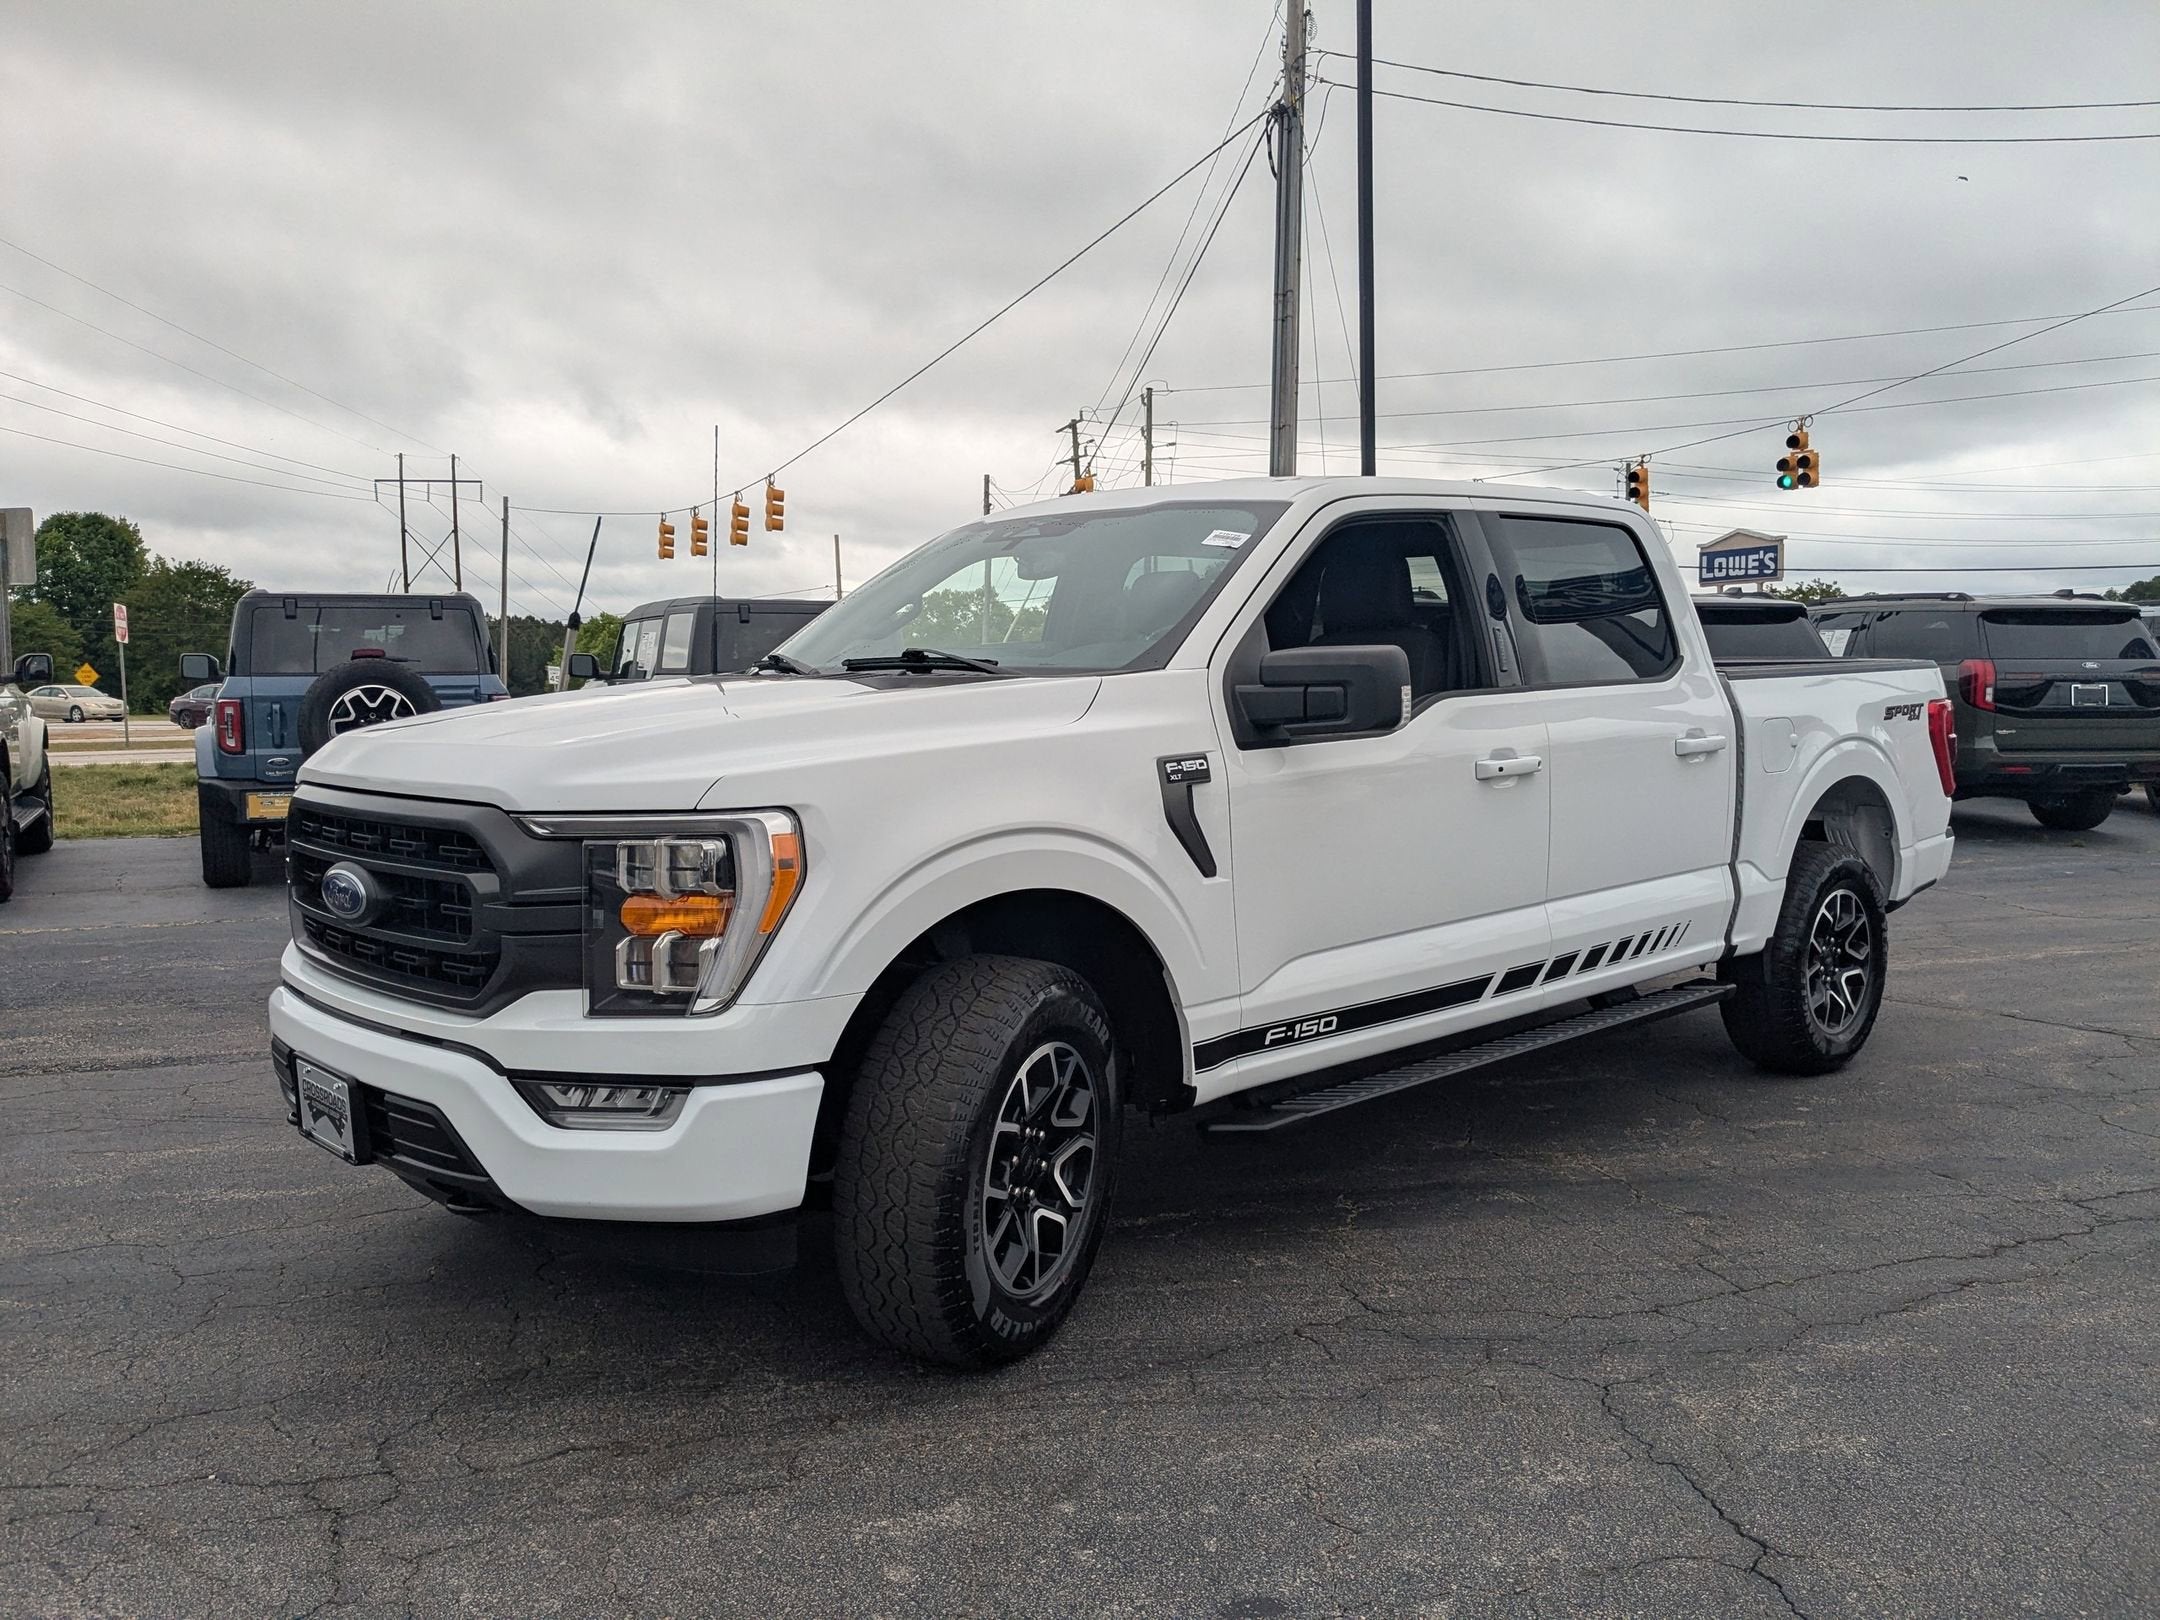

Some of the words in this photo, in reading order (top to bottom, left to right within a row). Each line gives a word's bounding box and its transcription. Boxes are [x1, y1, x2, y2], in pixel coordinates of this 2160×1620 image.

[1702, 550, 1776, 579] LOWE'S
[1883, 703, 1924, 721] SPORT
[1165, 759, 1208, 773] F-150
[1264, 1016, 1338, 1046] F-150
[303, 1078, 347, 1114] CROSSROADS
